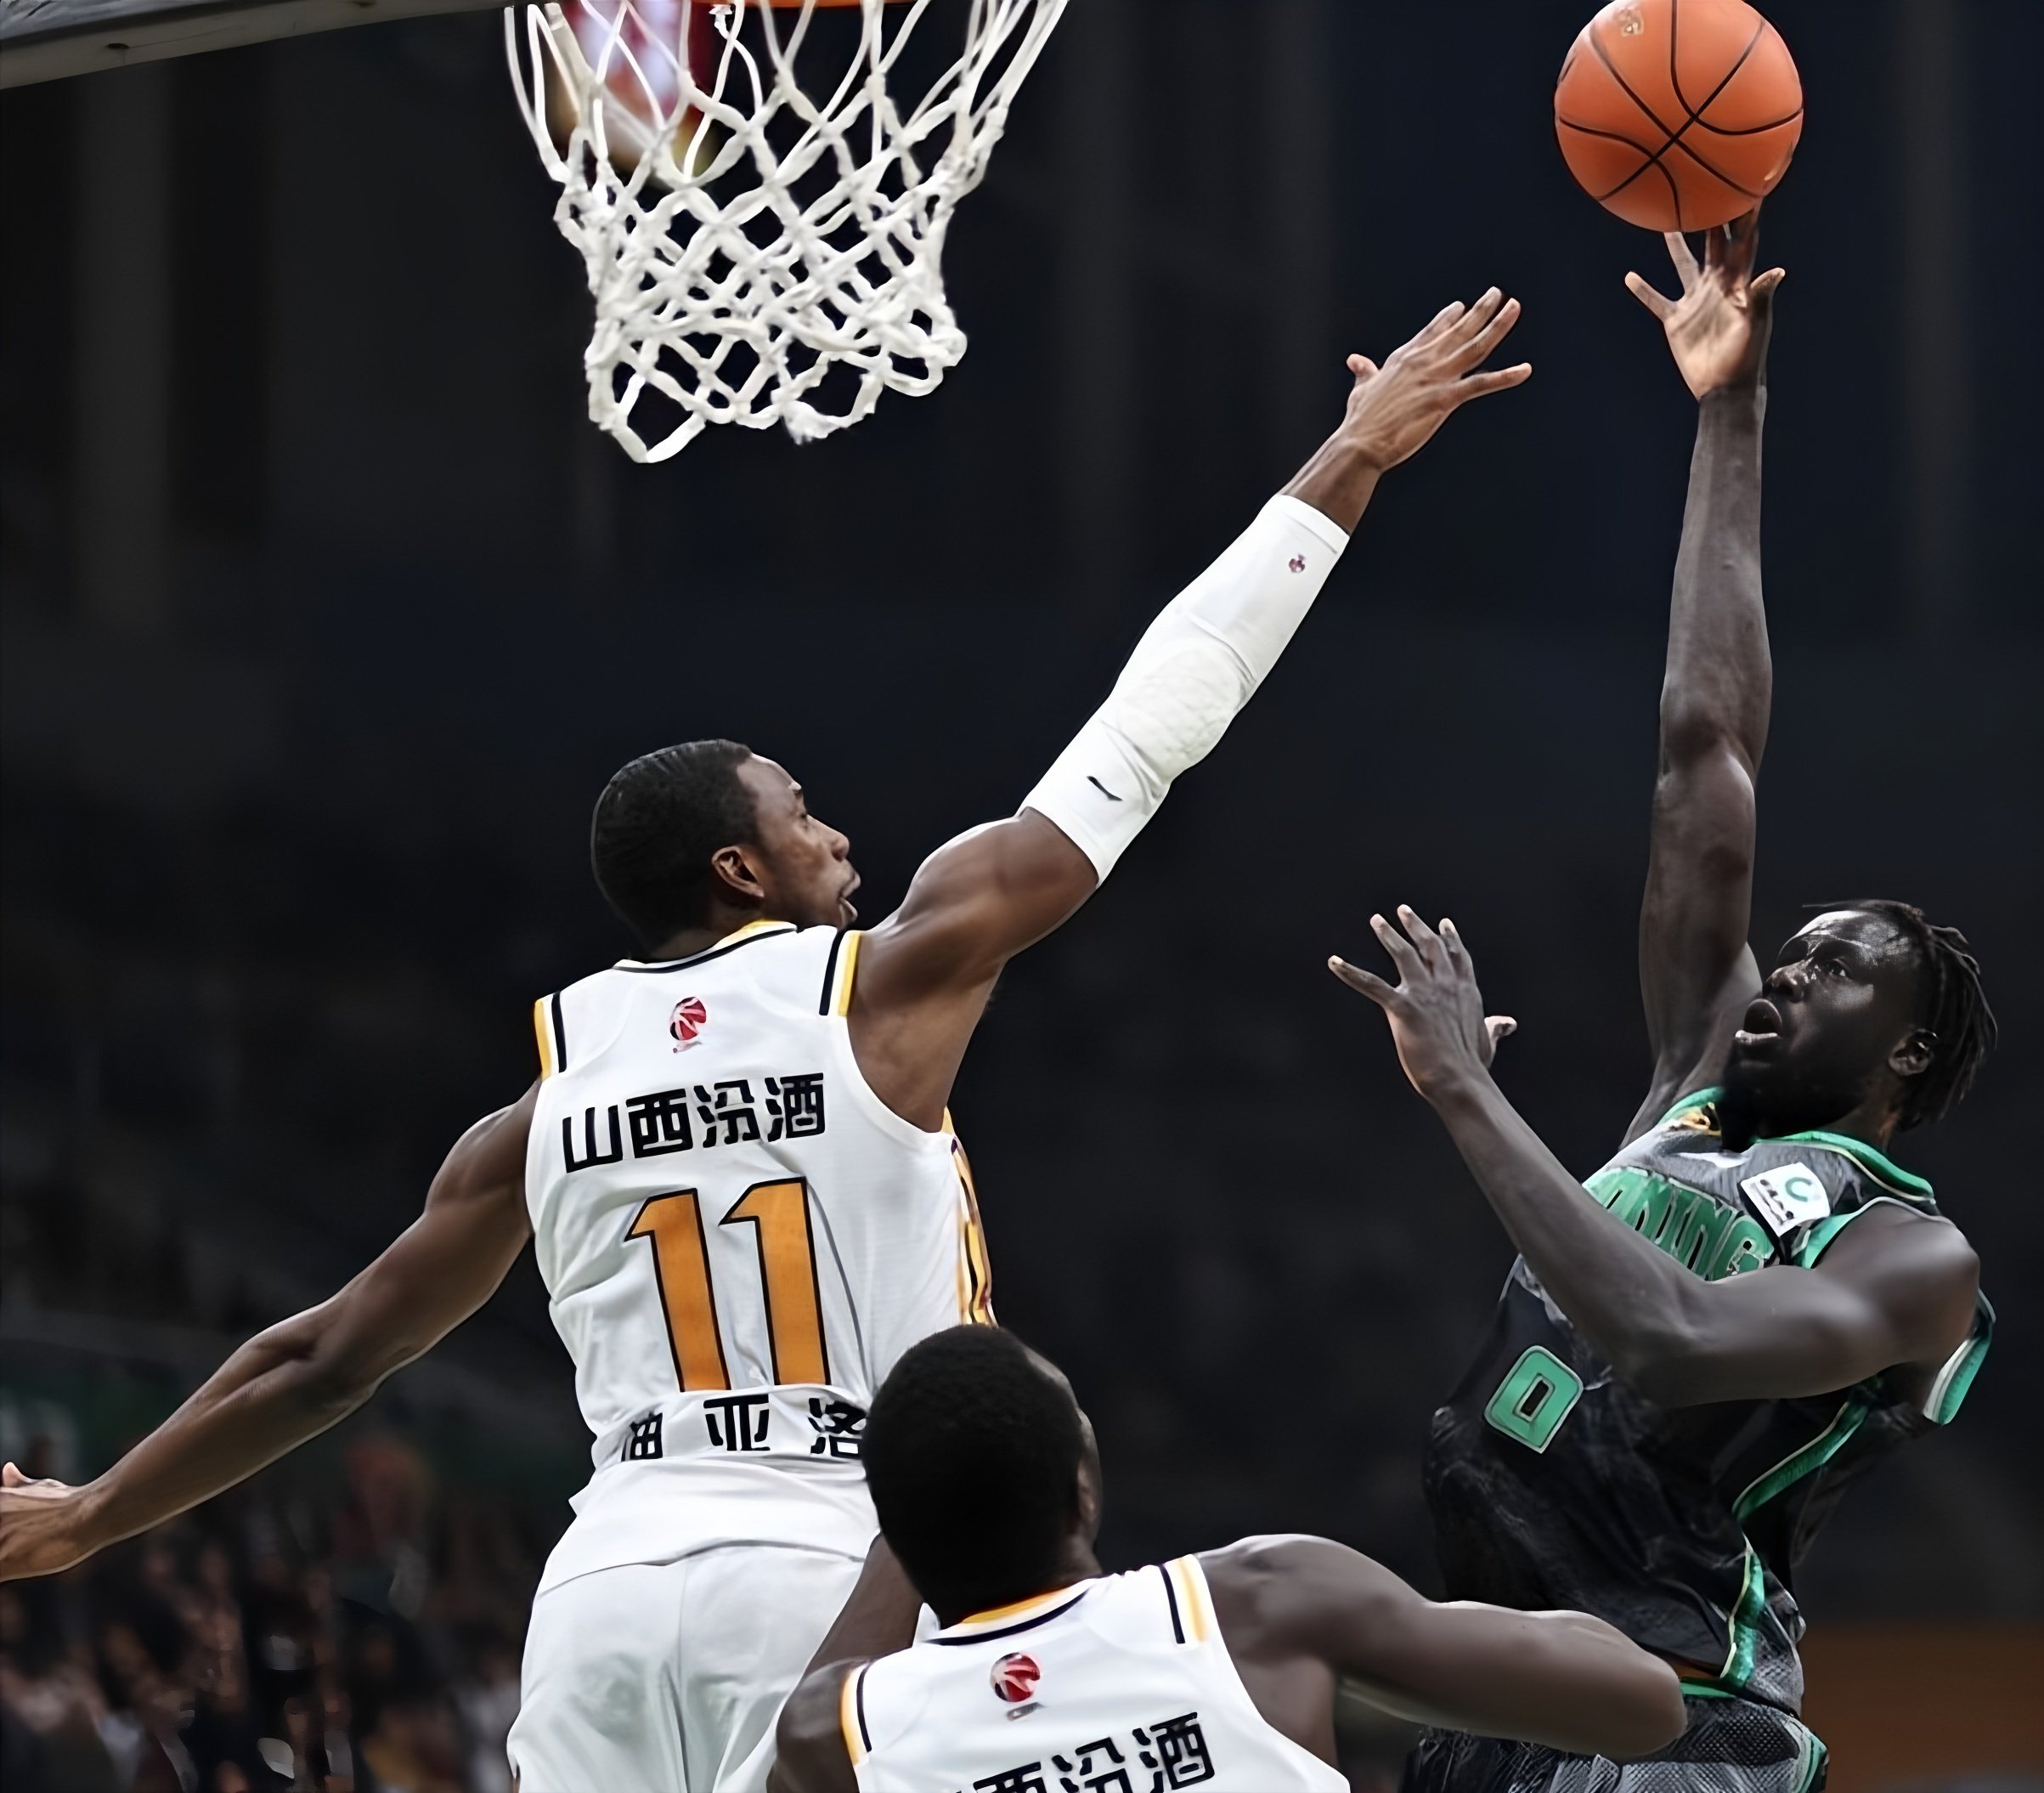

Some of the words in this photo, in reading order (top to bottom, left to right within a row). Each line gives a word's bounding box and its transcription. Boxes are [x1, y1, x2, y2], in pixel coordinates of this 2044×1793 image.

[562, 1072, 826, 1173] 山西汾酒
[624, 1176, 832, 1393] 11
